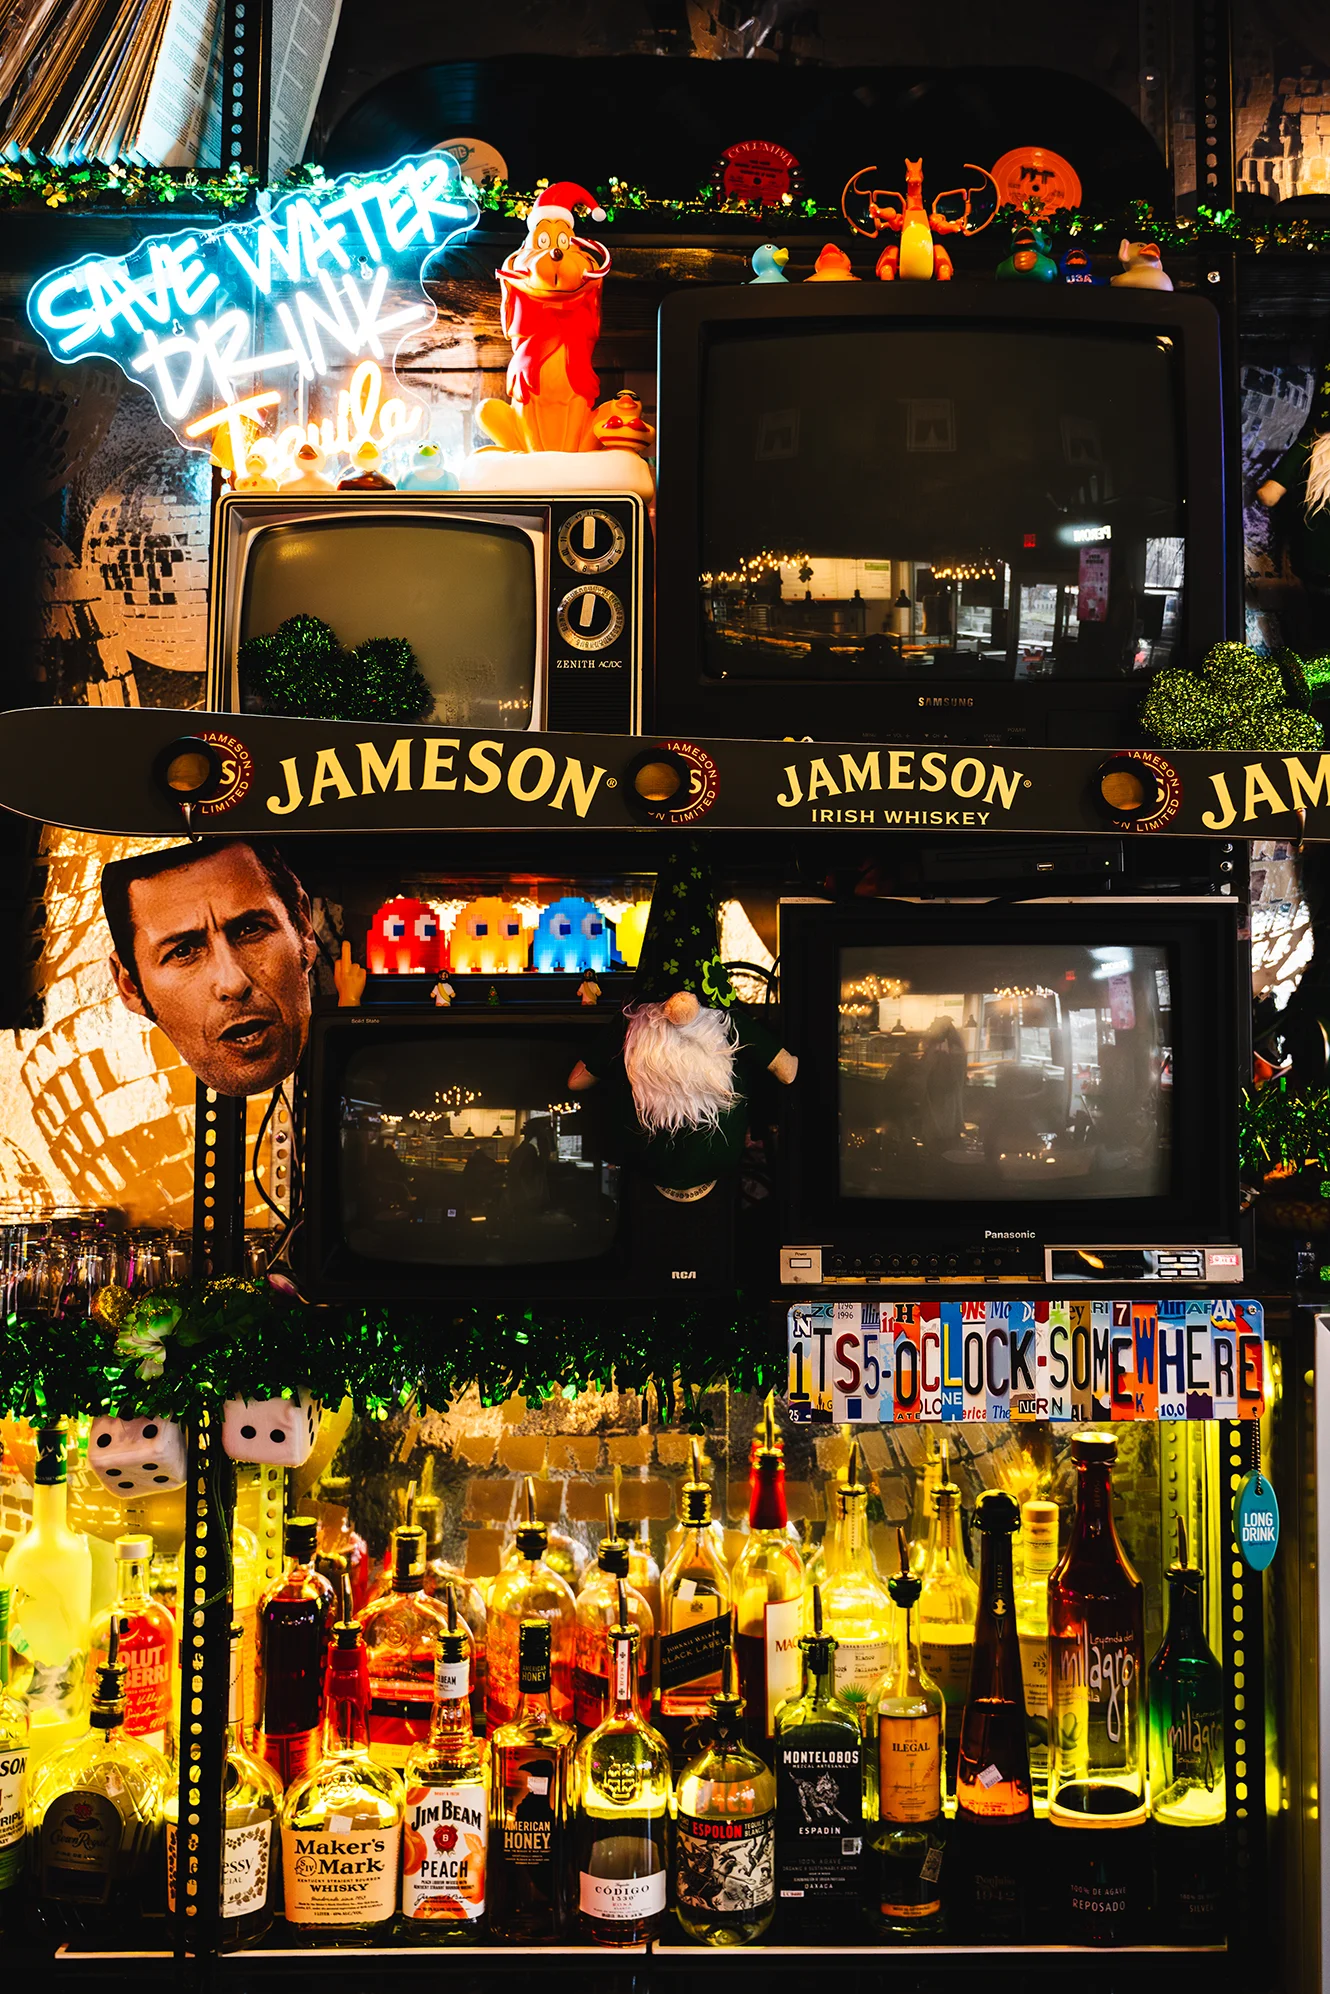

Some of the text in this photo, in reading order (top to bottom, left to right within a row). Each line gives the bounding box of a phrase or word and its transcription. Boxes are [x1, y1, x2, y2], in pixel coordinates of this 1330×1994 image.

[728, 142, 793, 167] COLUMBIA
[38, 158, 467, 352] SAVE WATER
[1066, 274, 1093, 285] USA
[133, 266, 428, 420] DRINK
[556, 660, 622, 669] ZENITH AC/DC
[918, 696, 974, 707] SAMSUNG
[203, 733, 251, 769] JAMESON
[266, 738, 607, 819] JAMESON
[776, 750, 1023, 812] JAMESON
[201, 781, 249, 814] LIMITED
[671, 790, 716, 823] LIMITED
[811, 809, 990, 827] IRISH WHISKEY
[1136, 798, 1179, 832] LIMITED
[985, 1230, 1036, 1240] Panasonic
[671, 1270, 696, 1279] RCA
[1116, 1304, 1127, 1325] 7
[1244, 1512, 1273, 1527] LONG
[1242, 1527, 1275, 1542] DRINK
[662, 1649, 694, 1665] BLACK
[696, 1637, 728, 1653] LABEL
[522, 1671, 547, 1682] HONEY
[892, 1742, 930, 1753] ILEGAL
[783, 1751, 859, 1764] MONTELOBOS
[411, 1800, 482, 1832] JIM BEAM
[505, 1821, 551, 1831] AMERICAN
[692, 1820, 742, 1839] ESPOLÓN
[294, 1839, 385, 1855] Maker's
[504, 1833, 551, 1849] HONEY
[318, 1858, 384, 1875] Mark
[421, 1861, 468, 1878] PEACH
[310, 1882, 369, 1893] WHISKY
[595, 1885, 650, 1896] CÓDIGO
[1092, 1888, 1102, 1896] DE
[1105, 1886, 1126, 1896] AGAVE
[1072, 1898, 1126, 1912] REPOSADO
